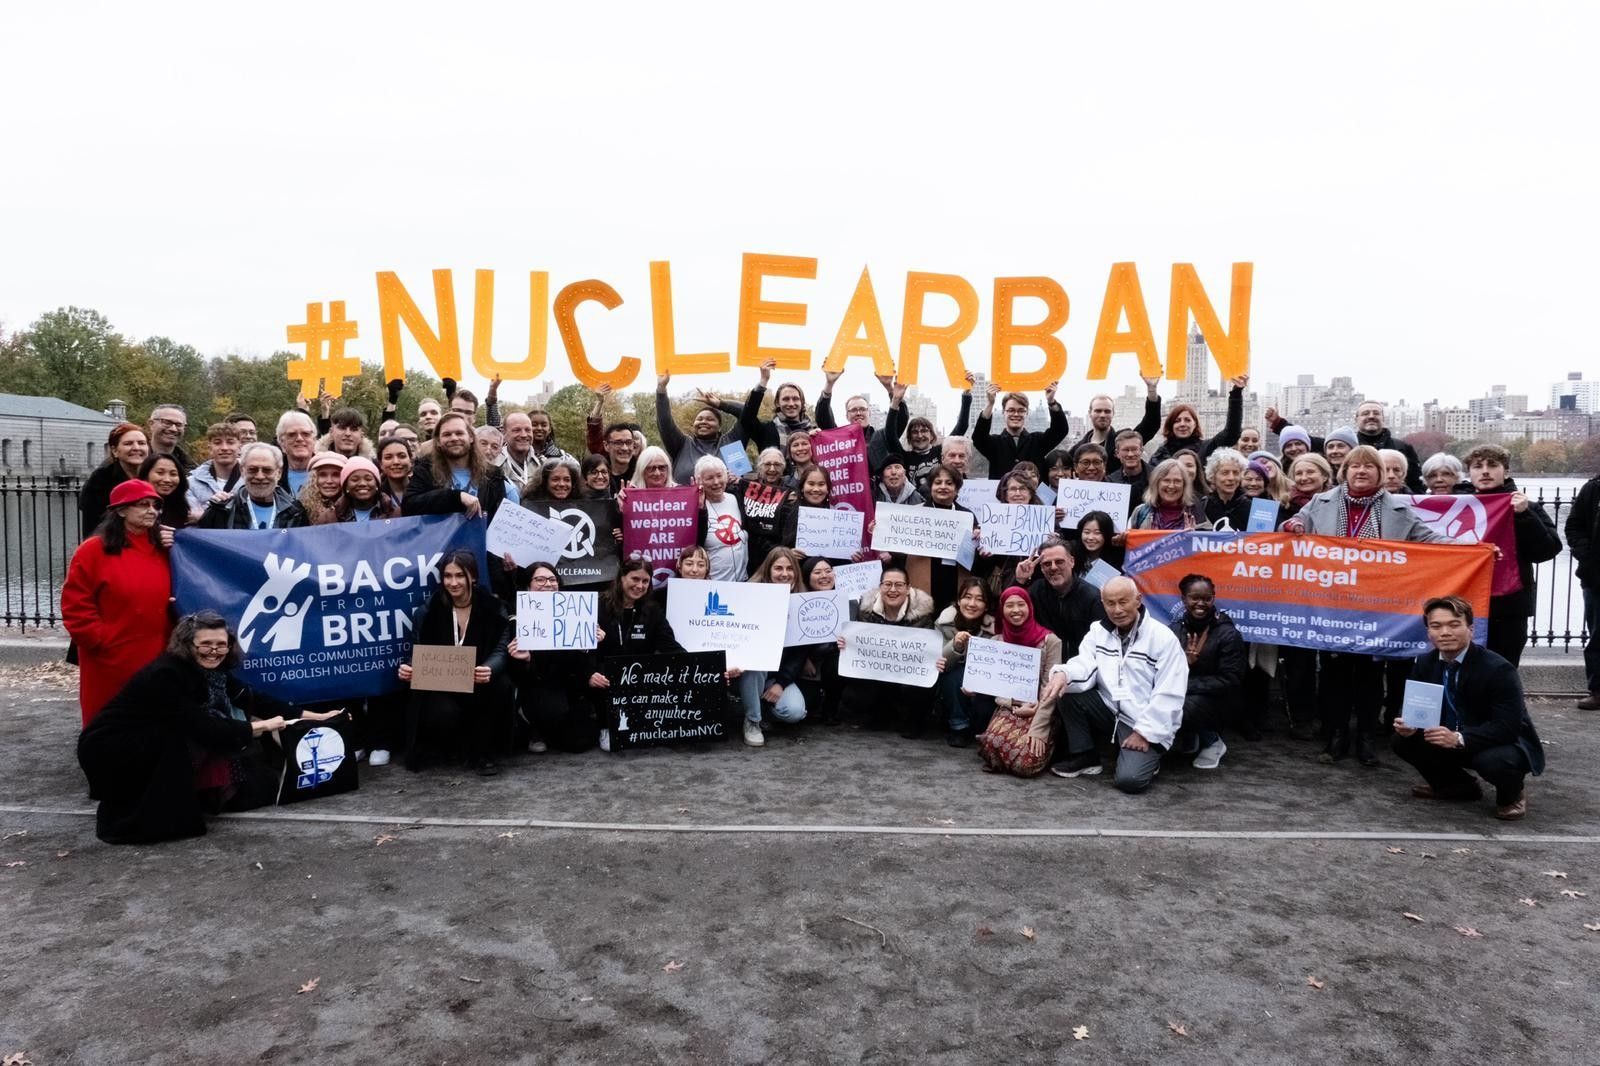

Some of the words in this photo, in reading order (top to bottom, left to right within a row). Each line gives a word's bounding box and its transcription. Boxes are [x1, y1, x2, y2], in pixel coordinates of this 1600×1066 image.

[286, 252, 1253, 399] #NUCLEARBAN
[816, 438, 857, 456] Nuclear
[829, 468, 849, 482] ARE
[745, 481, 787, 504] BAN
[830, 482, 864, 497] NNED
[1063, 486, 1095, 501] COOL
[1098, 490, 1122, 502] KIDS
[632, 499, 688, 512] Nuclear
[630, 517, 693, 531] weapons
[833, 513, 861, 523] HATE
[889, 513, 932, 527] NUCLEAR
[934, 518, 960, 530] WAR?
[1010, 504, 1055, 533] BANK
[648, 532, 675, 544] ARE
[832, 527, 858, 536] FEAR
[890, 525, 932, 538] NUCLEAR
[990, 530, 1006, 549] the
[899, 538, 924, 549] YOUR
[1129, 550, 1142, 562] As
[1145, 542, 1156, 553] of
[1192, 536, 1284, 556] Nuclear
[1292, 541, 1407, 565] Weapons
[633, 547, 686, 561] ANNE
[1134, 560, 1154, 572] 22,
[1155, 546, 1186, 564] 2021
[317, 552, 445, 597] BACK
[556, 567, 602, 576] UCLEARBAN
[1232, 561, 1273, 579] Are
[1281, 564, 1358, 588] Illegal
[321, 596, 385, 611] FROM
[408, 590, 433, 603] TH
[518, 592, 545, 611] The
[552, 592, 595, 617] BAN
[799, 600, 835, 616] DADDIES
[322, 607, 415, 648] BRIN
[689, 619, 725, 628] NUCLEAR
[726, 621, 740, 629] BAN
[741, 623, 760, 631] WEEK
[1249, 610, 1306, 625] Berrigan
[1310, 616, 1377, 632] Memorial
[518, 622, 530, 637] is
[532, 621, 548, 638] the
[553, 619, 596, 647] PLAN
[1235, 623, 1278, 637] terans
[1282, 628, 1303, 640] For
[1307, 631, 1427, 649] Peace-Baltimore
[855, 635, 898, 649] NUCLEAR
[901, 640, 927, 652] WAR?
[243, 653, 305, 670] BRINGING
[308, 645, 393, 663] COMMUNITIES
[399, 642, 411, 653] TO
[422, 653, 469, 664] NUCLEAR
[857, 648, 900, 662] NUCLEAR
[901, 653, 925, 664] BAN!
[261, 672, 276, 682] TO
[280, 664, 331, 681] ABOLISH
[334, 661, 382, 676] NUCLEAR
[383, 658, 404, 669] WE
[422, 666, 442, 677] BAN
[620, 662, 643, 686] We
[643, 665, 674, 685] made
[678, 666, 689, 684] it
[693, 665, 720, 684] here
[868, 661, 892, 672] YOUR
[893, 664, 929, 676] CHOICE!
[612, 695, 628, 705] we
[631, 694, 649, 704] can
[651, 690, 678, 704] make
[683, 690, 693, 704] it
[644, 705, 702, 727] anywhere
[629, 723, 723, 742] #nuclearbanNYC
